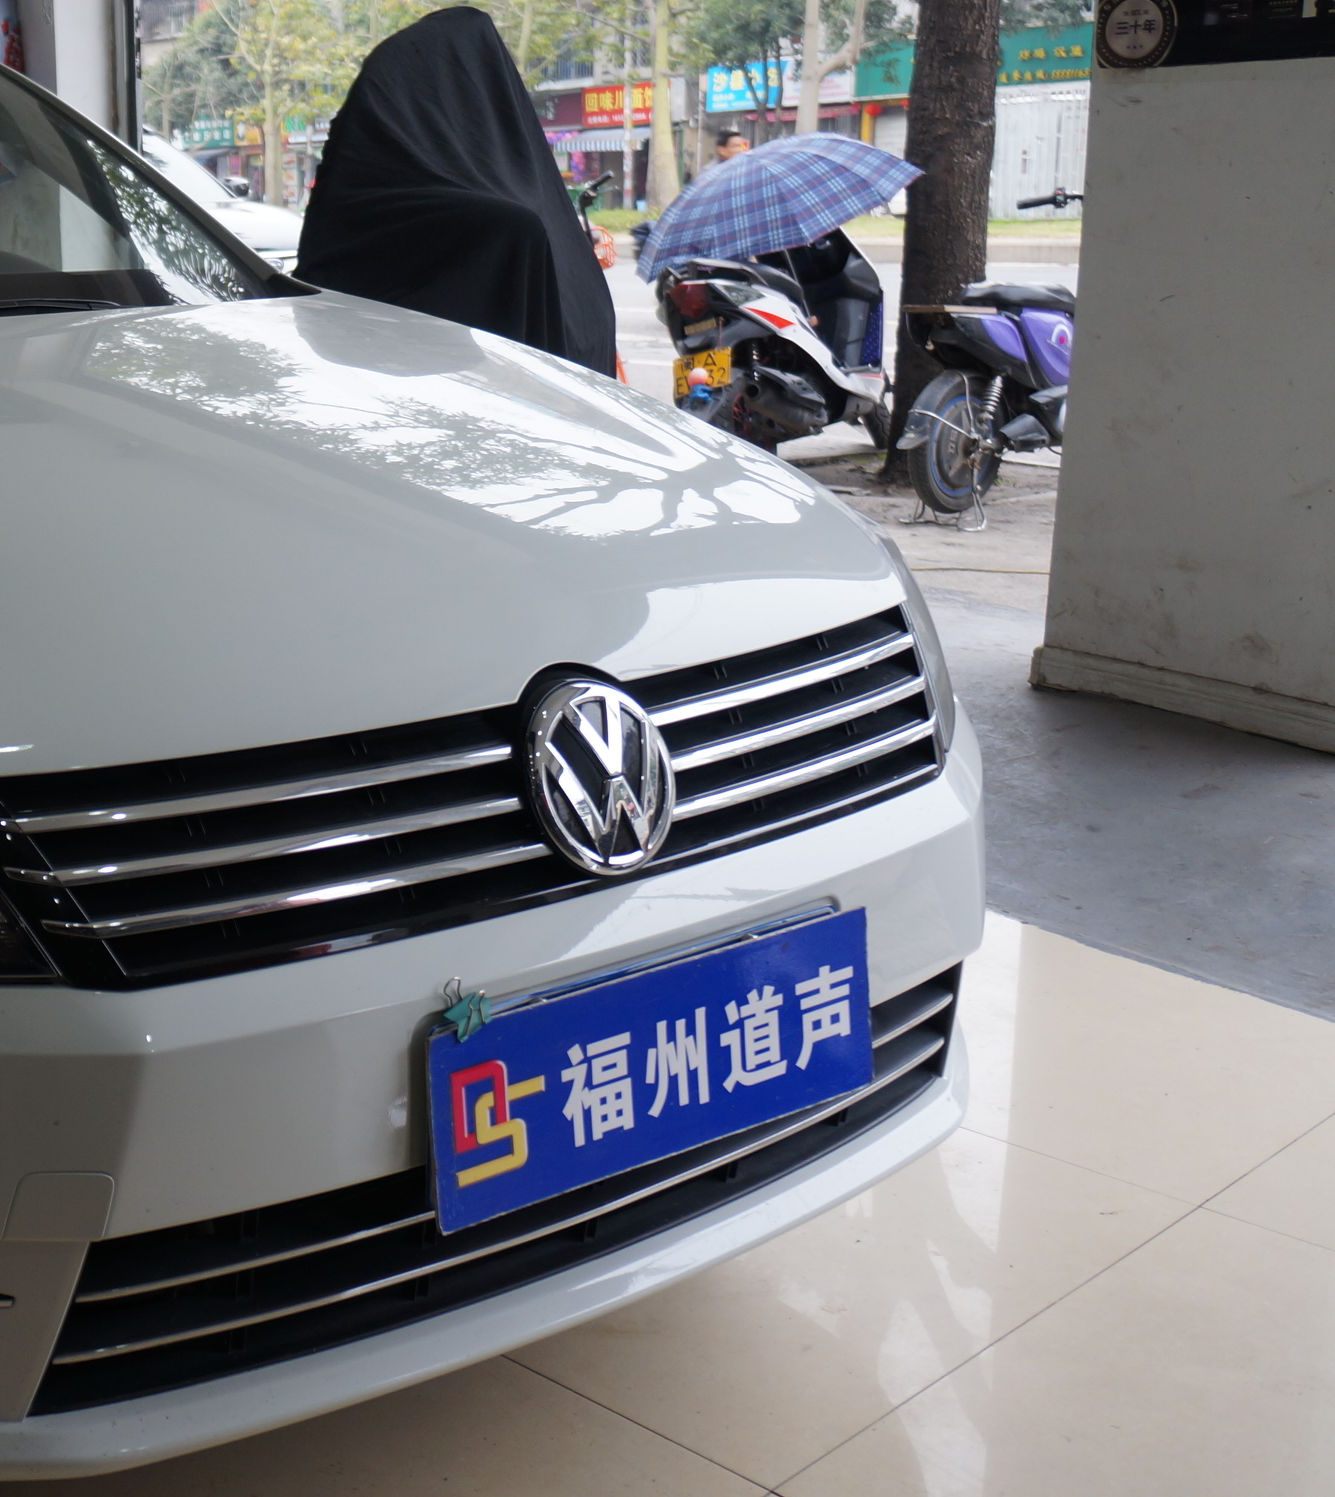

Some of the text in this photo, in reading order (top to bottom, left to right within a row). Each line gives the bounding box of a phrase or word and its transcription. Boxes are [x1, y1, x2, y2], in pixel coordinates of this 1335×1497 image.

[1114, 19, 1156, 35] 三十年
[561, 965, 854, 1148] 福州道声
